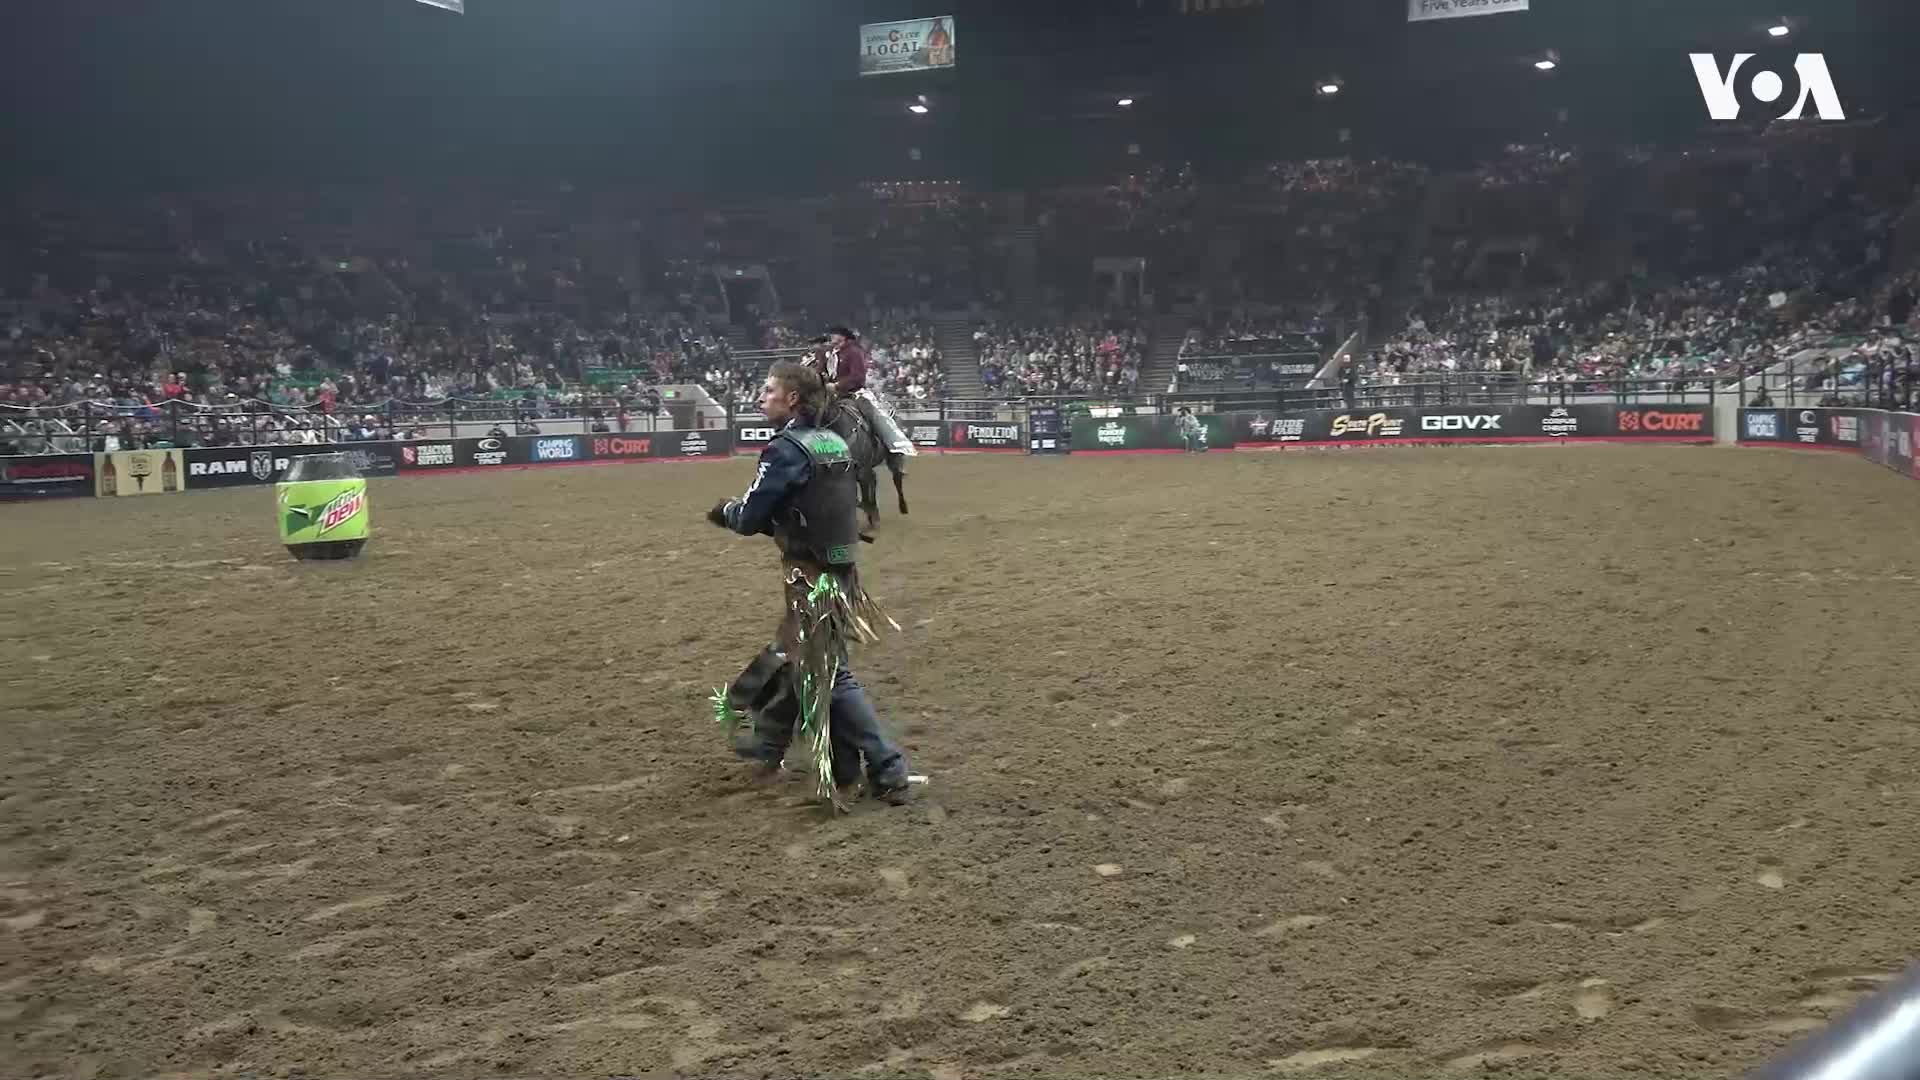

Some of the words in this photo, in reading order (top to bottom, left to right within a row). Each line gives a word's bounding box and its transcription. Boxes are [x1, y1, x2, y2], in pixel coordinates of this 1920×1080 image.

[866, 41, 921, 56] LOCAL
[1421, 415, 1501, 430] GOVX
[1642, 411, 1703, 431] CURT
[968, 425, 1018, 441] PENDLETON
[537, 447, 574, 459] WORLD
[610, 437, 650, 454] CURT
[190, 460, 247, 475] RAM
